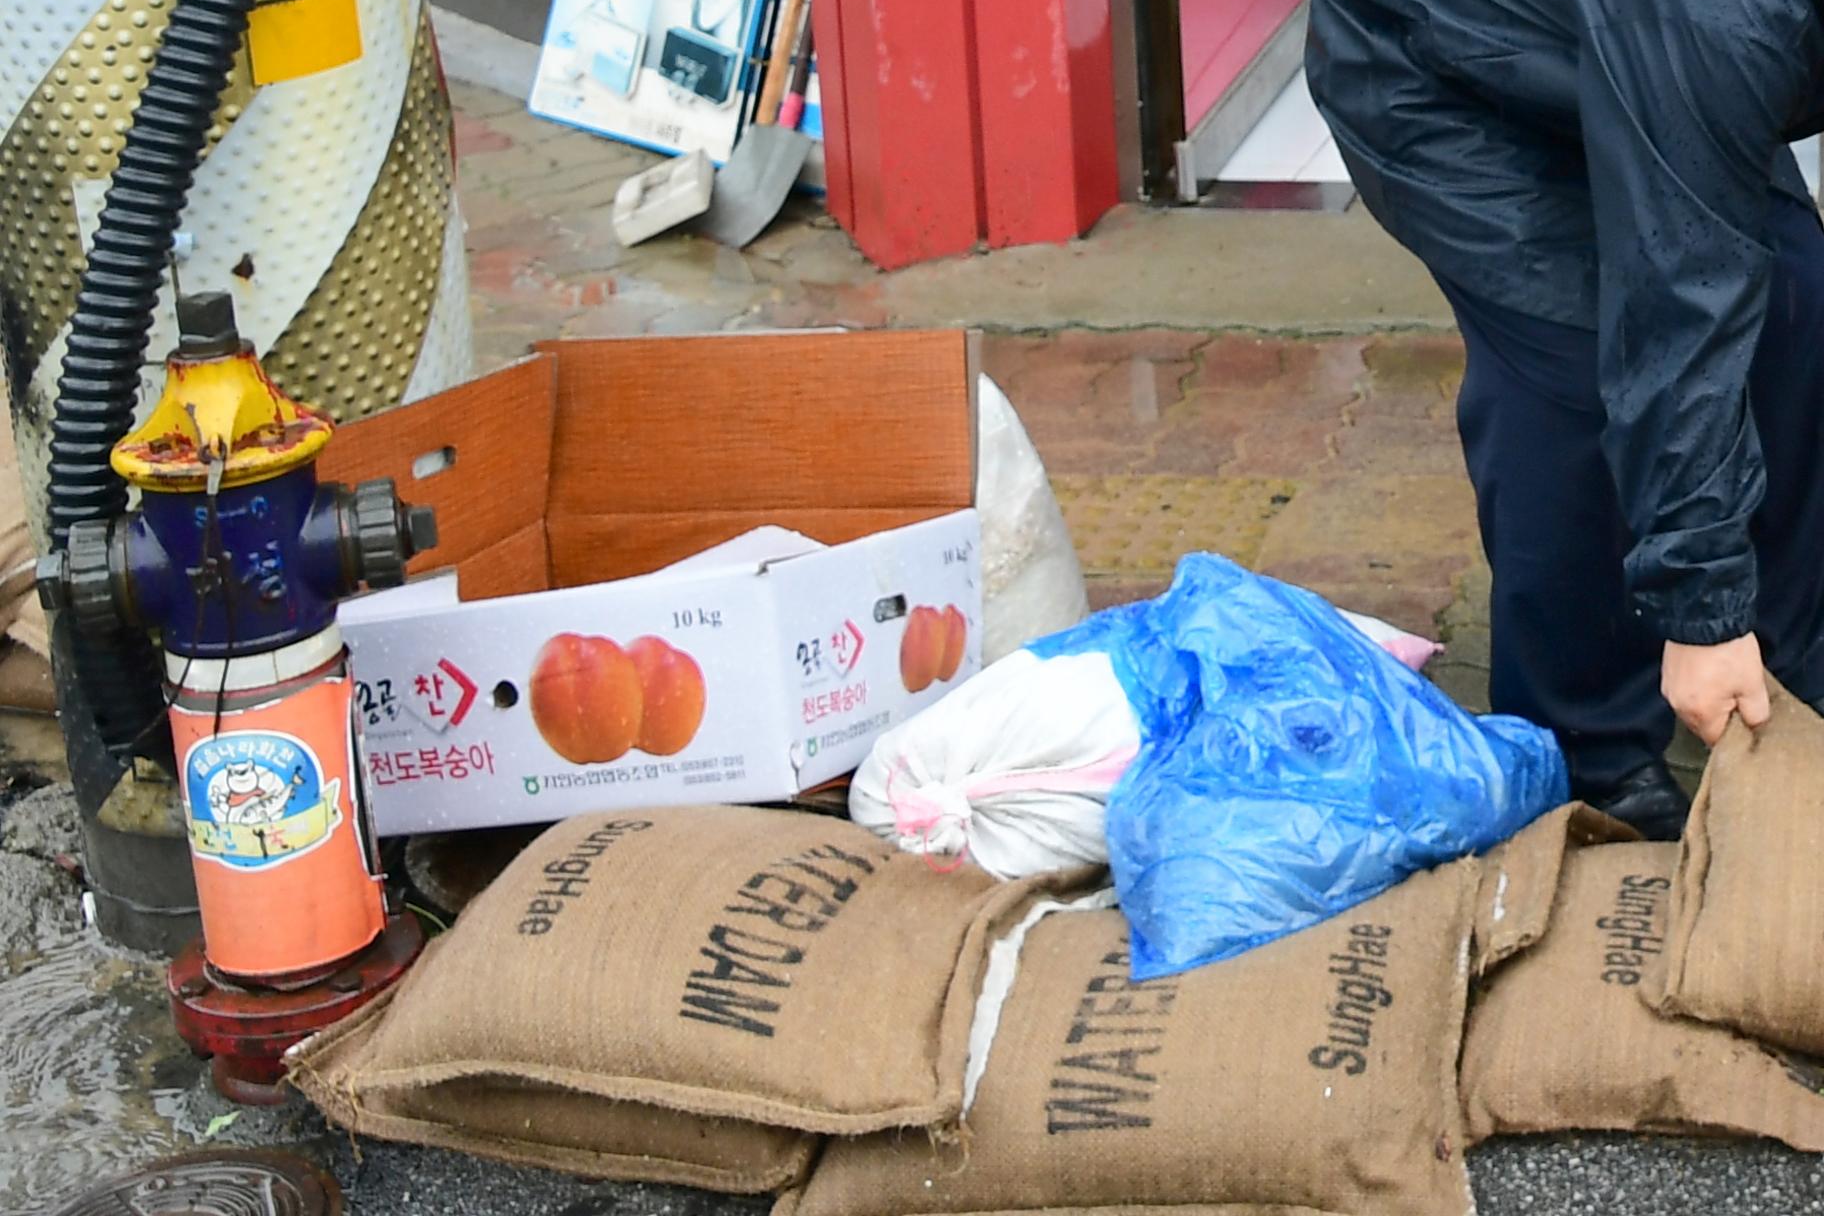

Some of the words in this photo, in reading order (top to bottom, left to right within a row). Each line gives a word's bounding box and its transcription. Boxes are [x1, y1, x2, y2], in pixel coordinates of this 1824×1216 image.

[673, 610, 693, 628] 10
[698, 608, 723, 627] kg
[370, 741, 495, 785] 천도복숭아
[803, 680, 867, 744] 천도복숭아
[518, 818, 654, 937] SungHae
[1596, 873, 1671, 985] SungHae
[679, 924, 807, 1038] DAM
[1308, 923, 1393, 1077] SungHae
[1045, 972, 1181, 1135] WATER
